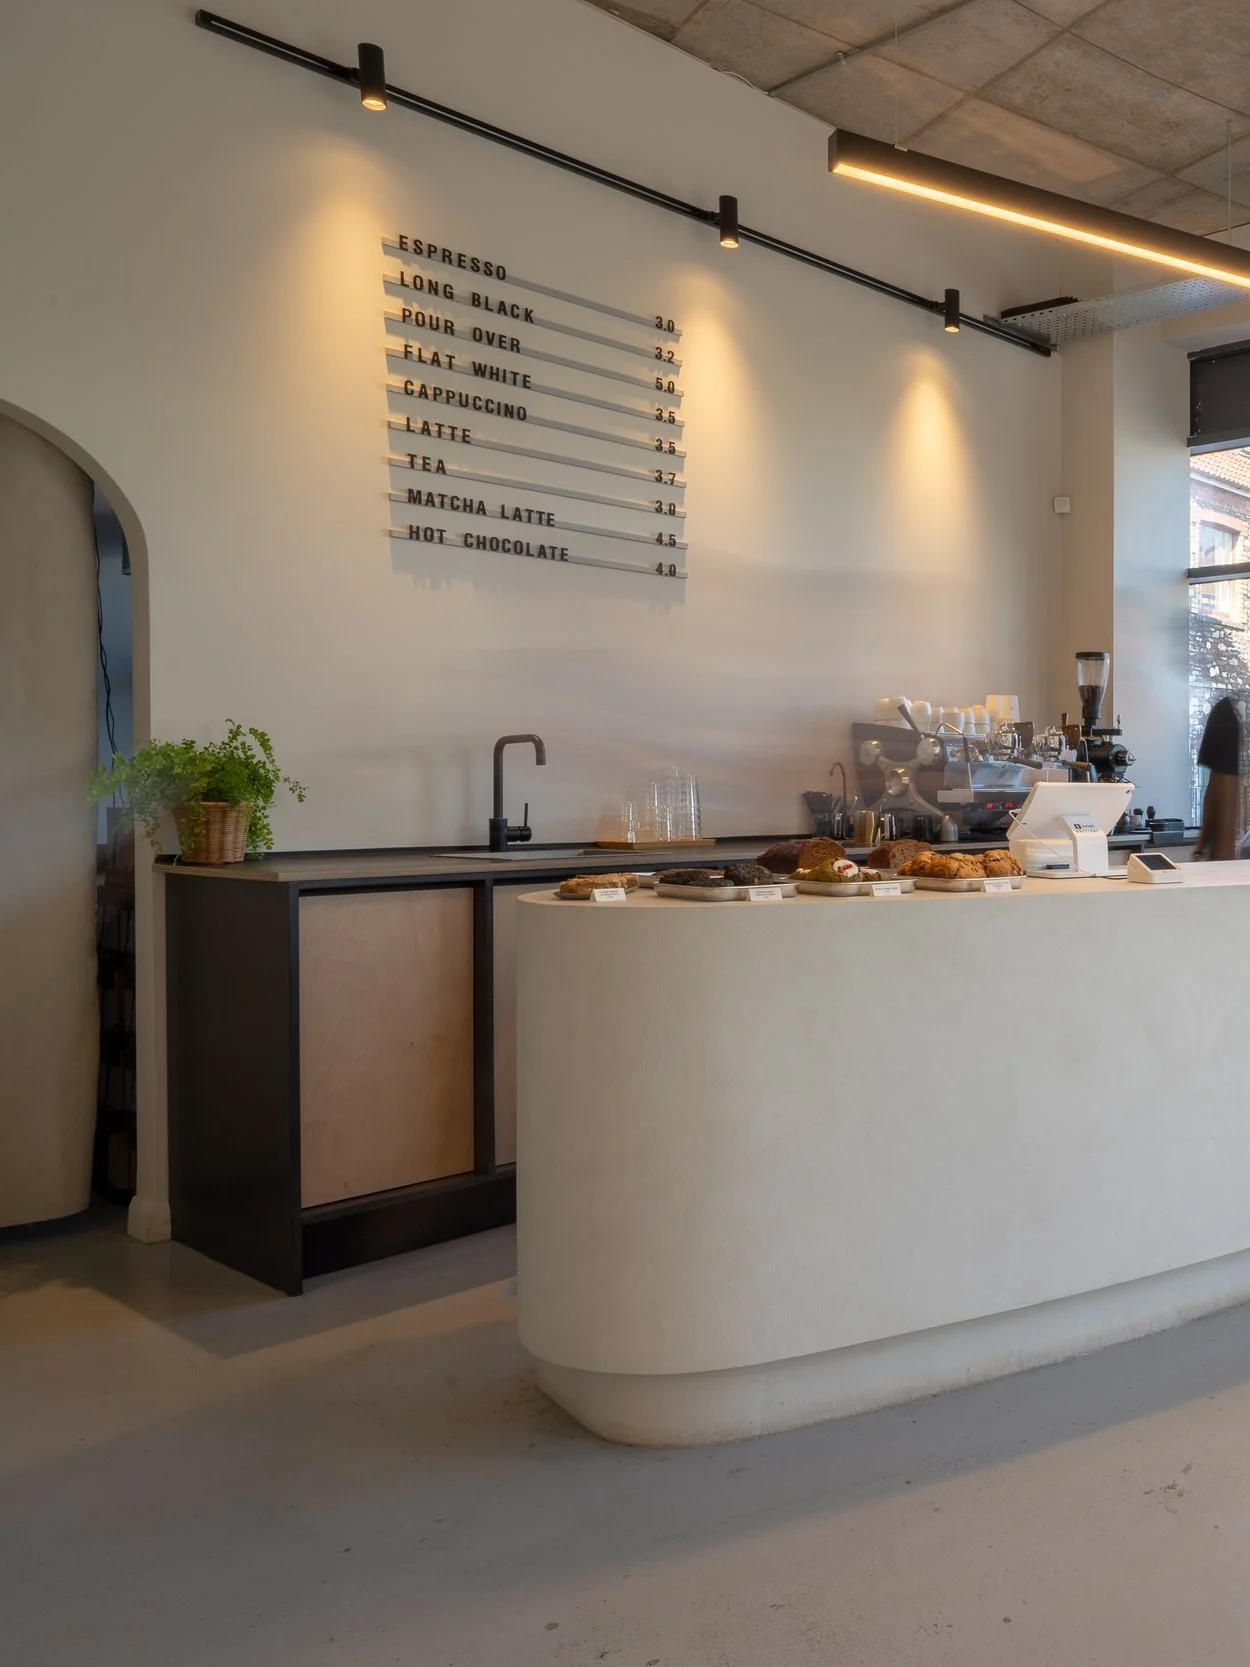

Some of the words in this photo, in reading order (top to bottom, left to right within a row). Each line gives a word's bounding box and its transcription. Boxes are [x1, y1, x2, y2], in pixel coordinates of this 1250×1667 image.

[399, 235, 506, 281] ESPRESSO
[655, 316, 674, 333] 3.0
[400, 271, 454, 300] LONG
[472, 293, 534, 323] BLACK
[655, 347, 675, 364] 3.2
[402, 308, 455, 335] POUR
[473, 327, 521, 353] OVER
[656, 378, 675, 394] 5.0
[404, 344, 455, 370] FLAT
[472, 361, 532, 389] WHITE
[656, 408, 675, 424] 3.5
[404, 380, 527, 421] CAPPUCCINO
[656, 439, 676, 454] 3.5
[406, 417, 471, 443] LATTE
[656, 470, 676, 485] 3.7
[408, 454, 447, 474] TEA
[655, 501, 676, 516] 3.0
[408, 489, 487, 515] MATCHA
[501, 505, 555, 527] LATTE
[656, 532, 677, 547] 4.5
[409, 525, 446, 544] HOT
[464, 533, 568, 561] CHOCOLATE
[656, 563, 676, 577] 4.0
